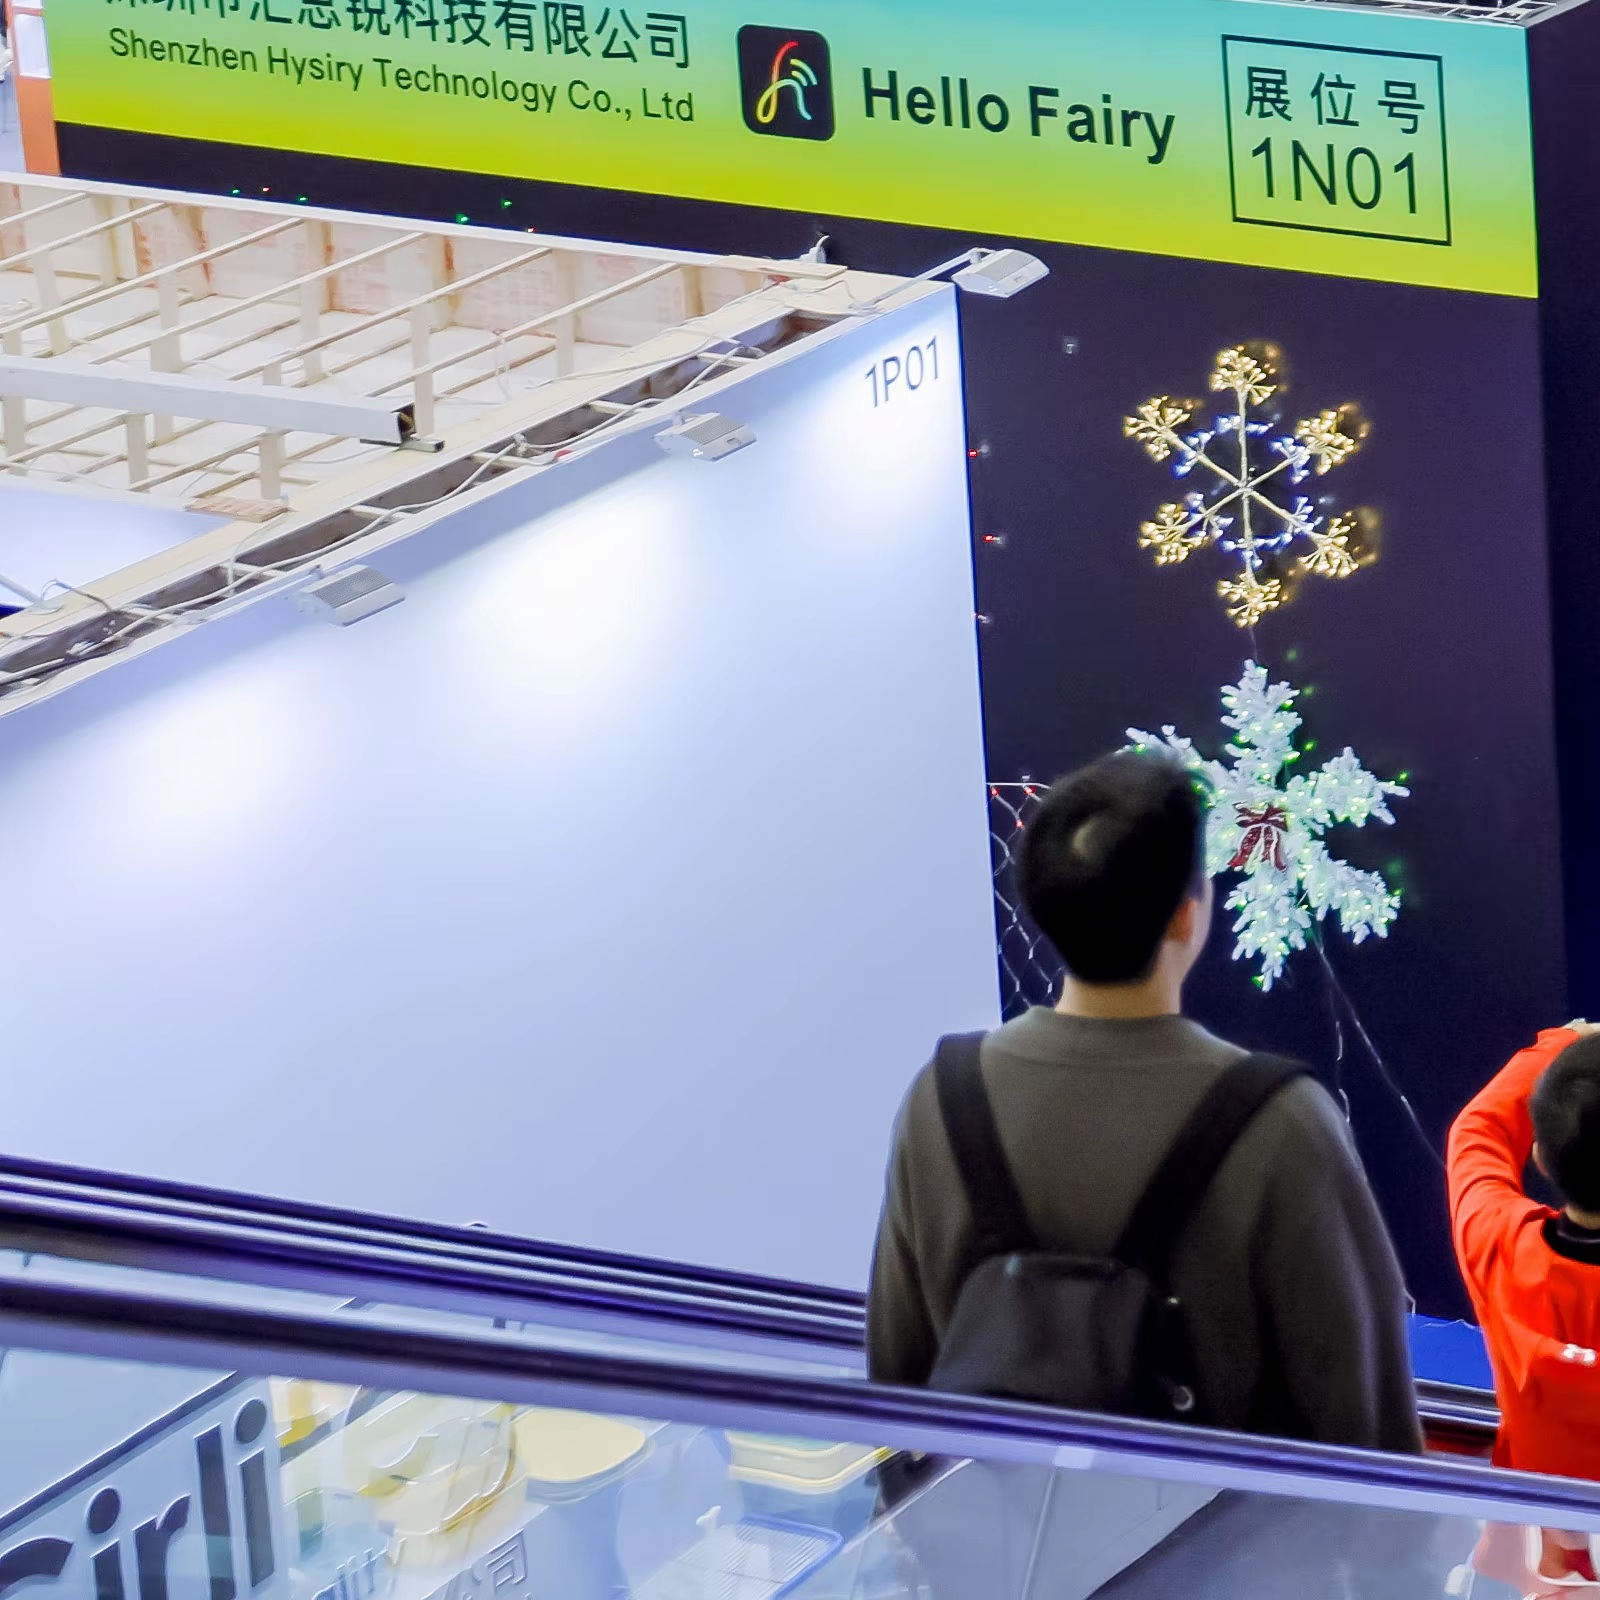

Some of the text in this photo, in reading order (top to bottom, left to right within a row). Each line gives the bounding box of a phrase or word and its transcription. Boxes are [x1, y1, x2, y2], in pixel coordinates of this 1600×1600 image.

[108, 27, 695, 123] Shenzhen Hysiry Technology Co., Ltd
[1244, 65, 1427, 137] 展位号
[862, 67, 1176, 166] Hello Fairy
[1251, 136, 1420, 215] 1N01
[862, 334, 942, 410] 1P01
